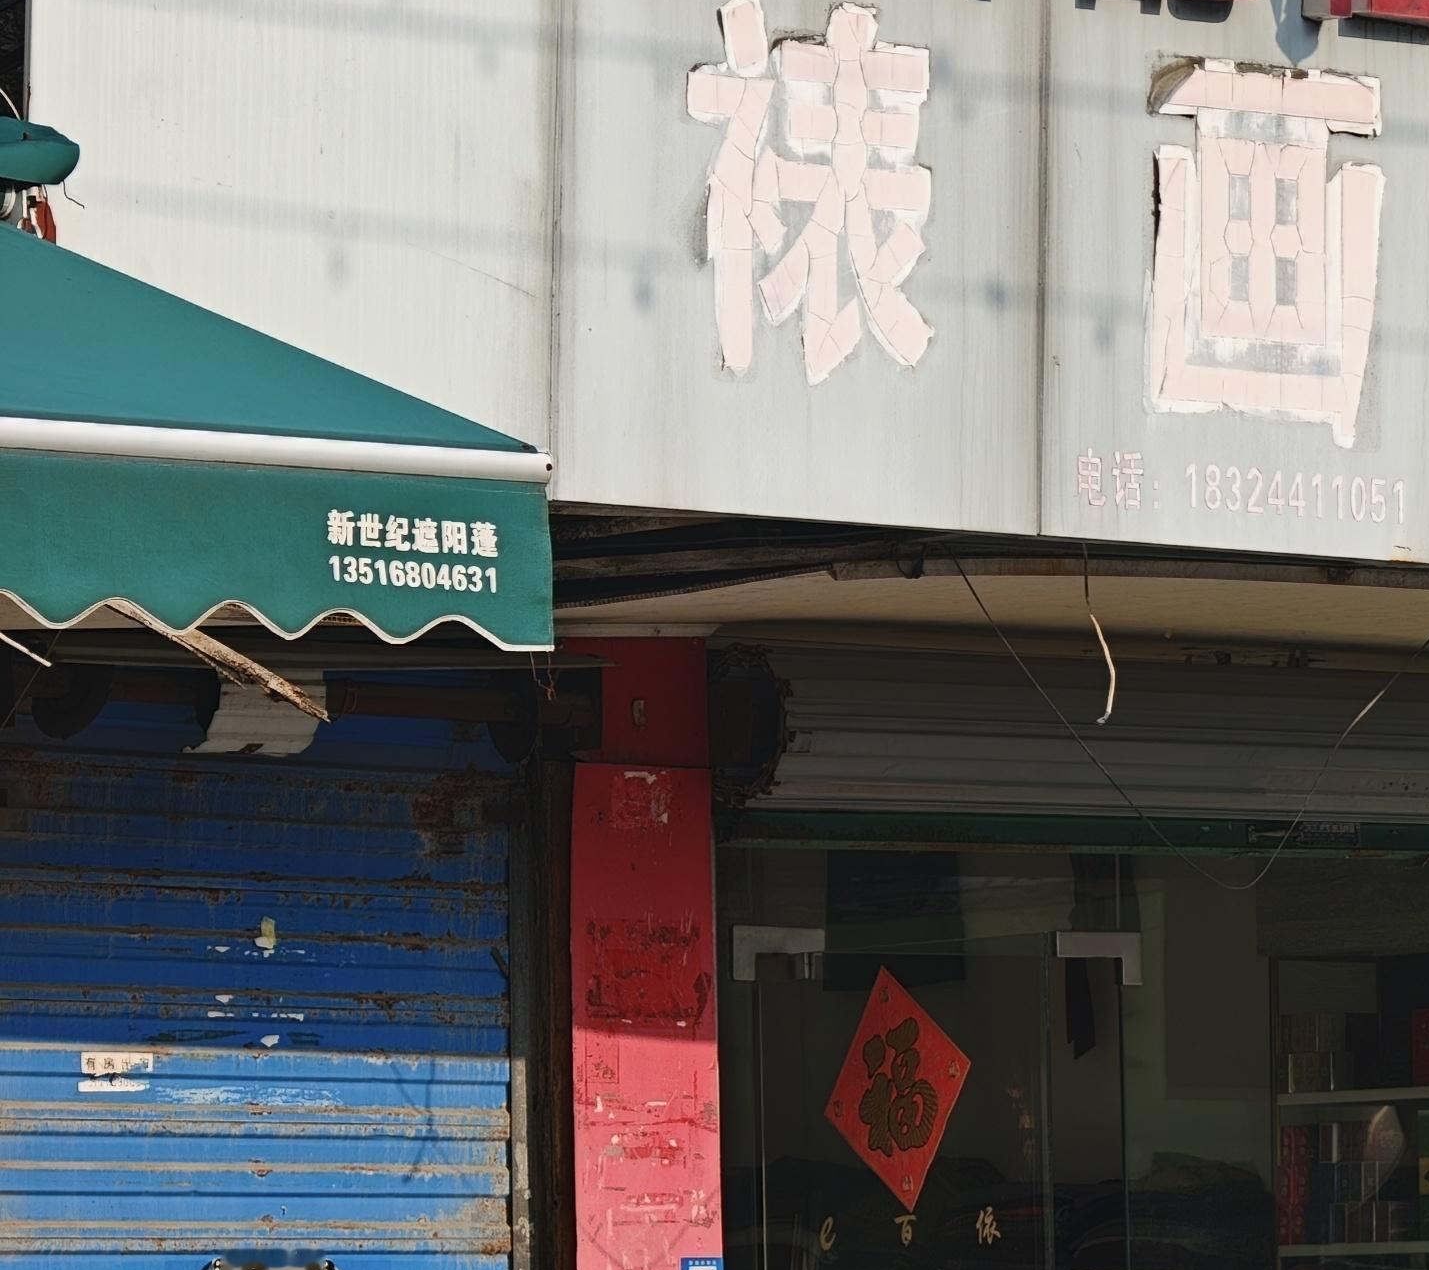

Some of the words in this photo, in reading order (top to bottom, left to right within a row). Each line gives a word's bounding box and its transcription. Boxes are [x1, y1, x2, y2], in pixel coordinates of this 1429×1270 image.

[1186, 463, 1405, 524] 18324411051
[328, 555, 497, 594] 13516804631
[859, 1017, 939, 1159] 福
